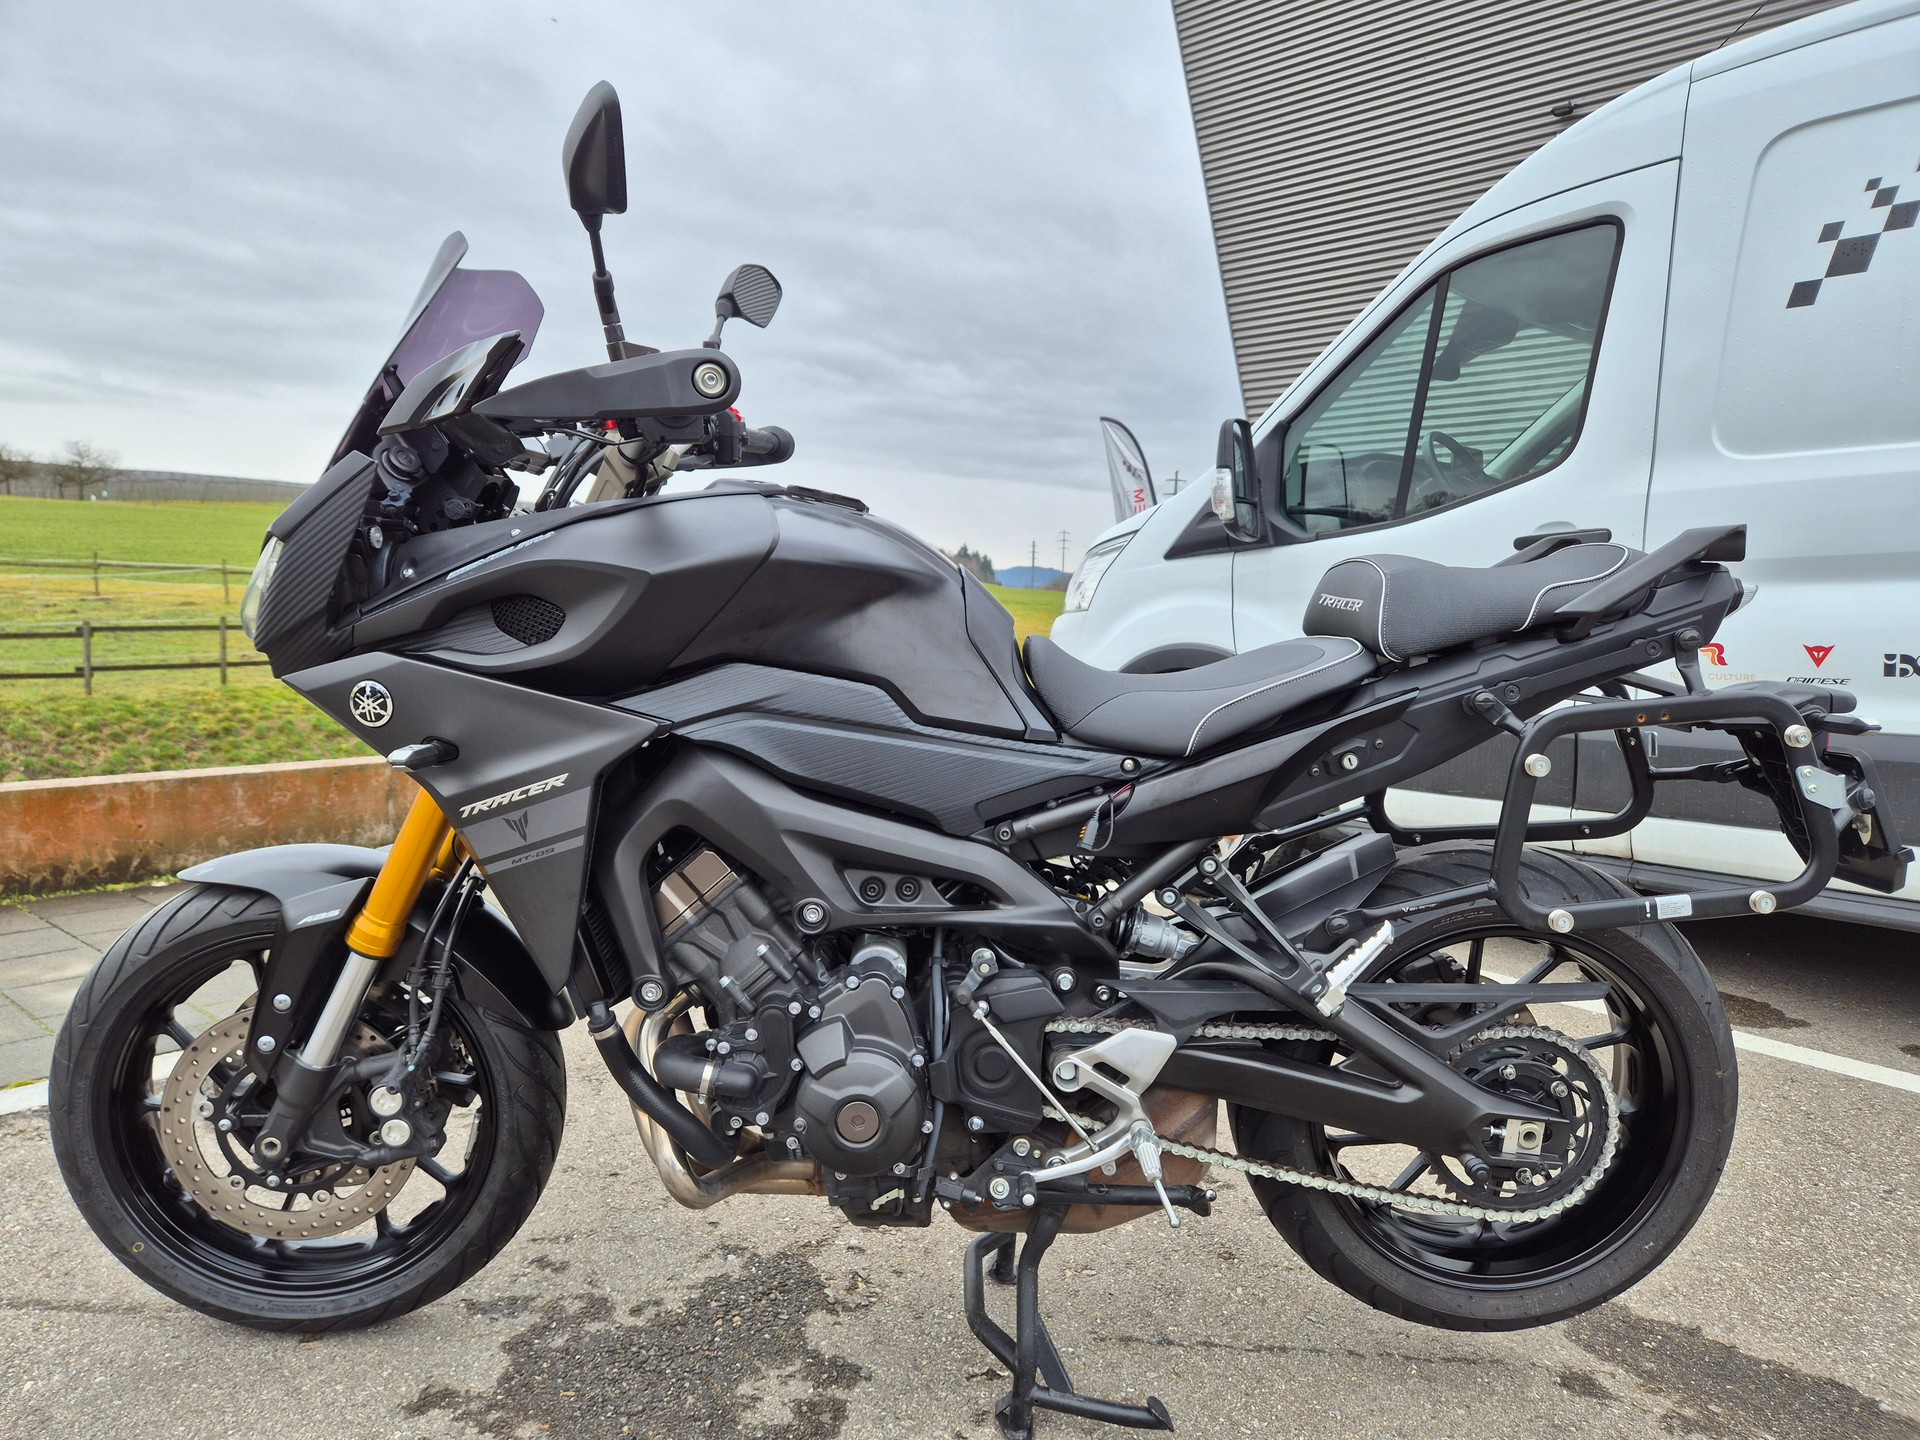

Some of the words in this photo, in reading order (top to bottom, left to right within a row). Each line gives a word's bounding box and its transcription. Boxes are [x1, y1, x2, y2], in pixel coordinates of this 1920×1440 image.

[1318, 593, 1364, 612] TRACER
[1708, 673, 1756, 682] CULTURE
[1786, 676, 1851, 686] DAINESE
[459, 773, 569, 818] TRACER
[512, 848, 555, 864] MT-09
